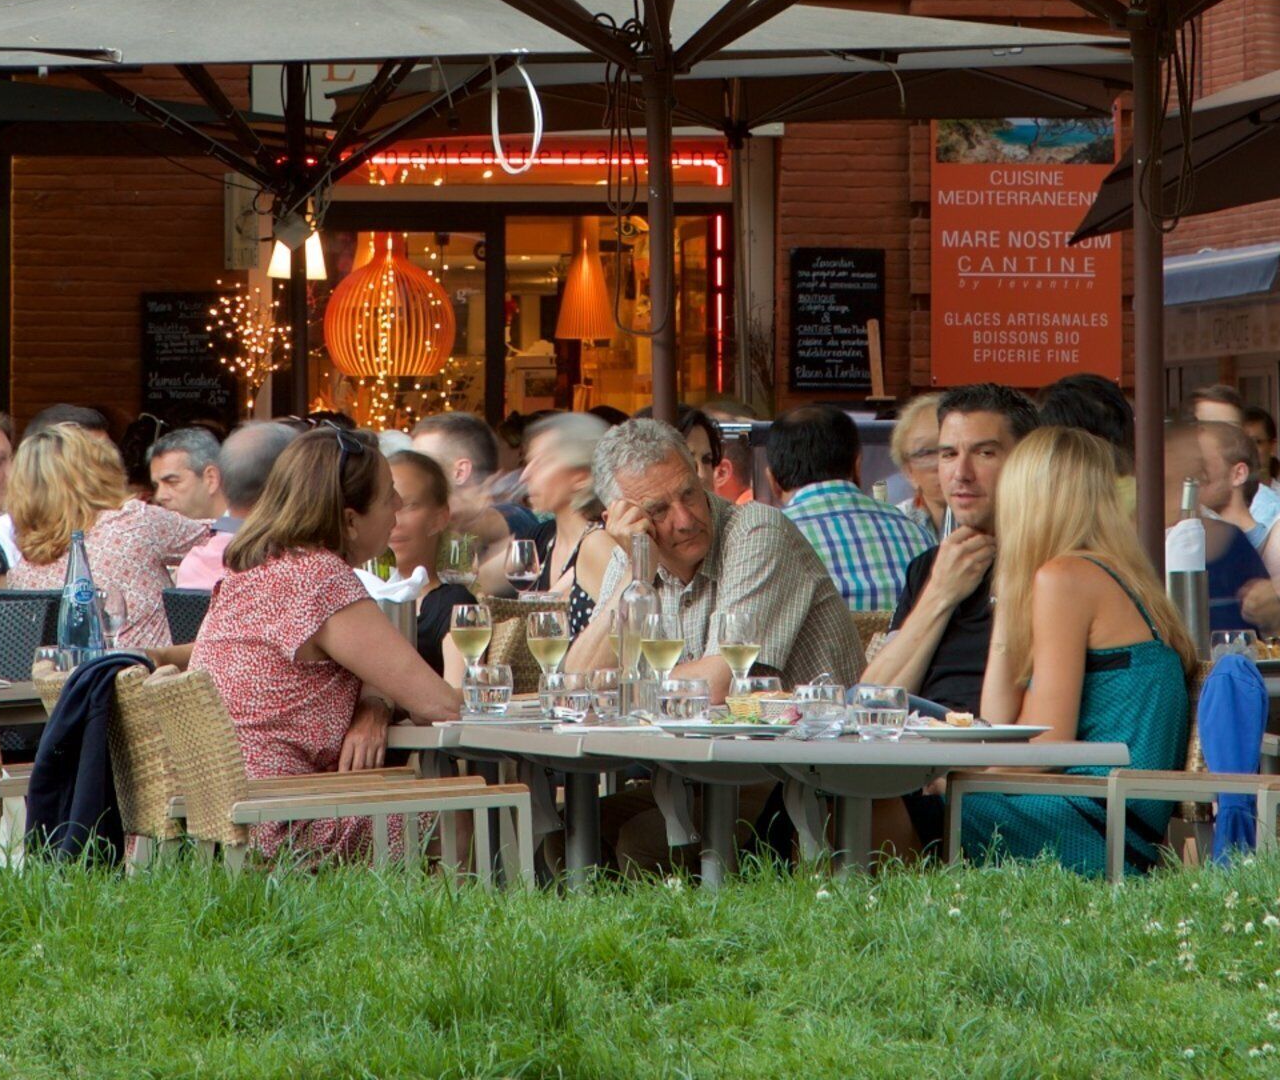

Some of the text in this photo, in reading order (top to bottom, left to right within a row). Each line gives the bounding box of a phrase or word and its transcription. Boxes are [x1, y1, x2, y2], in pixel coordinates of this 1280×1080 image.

[990, 169, 1064, 186] CUISINE
[942, 230, 1000, 248] MARE
[957, 256, 1096, 273] CANTINE
[958, 279, 1095, 290] by levantin
[944, 311, 1109, 327] GLACES ARTISANALES
[973, 330, 1080, 345] BOISSONS BIO
[974, 348, 1079, 363] EPICERIE FINE
